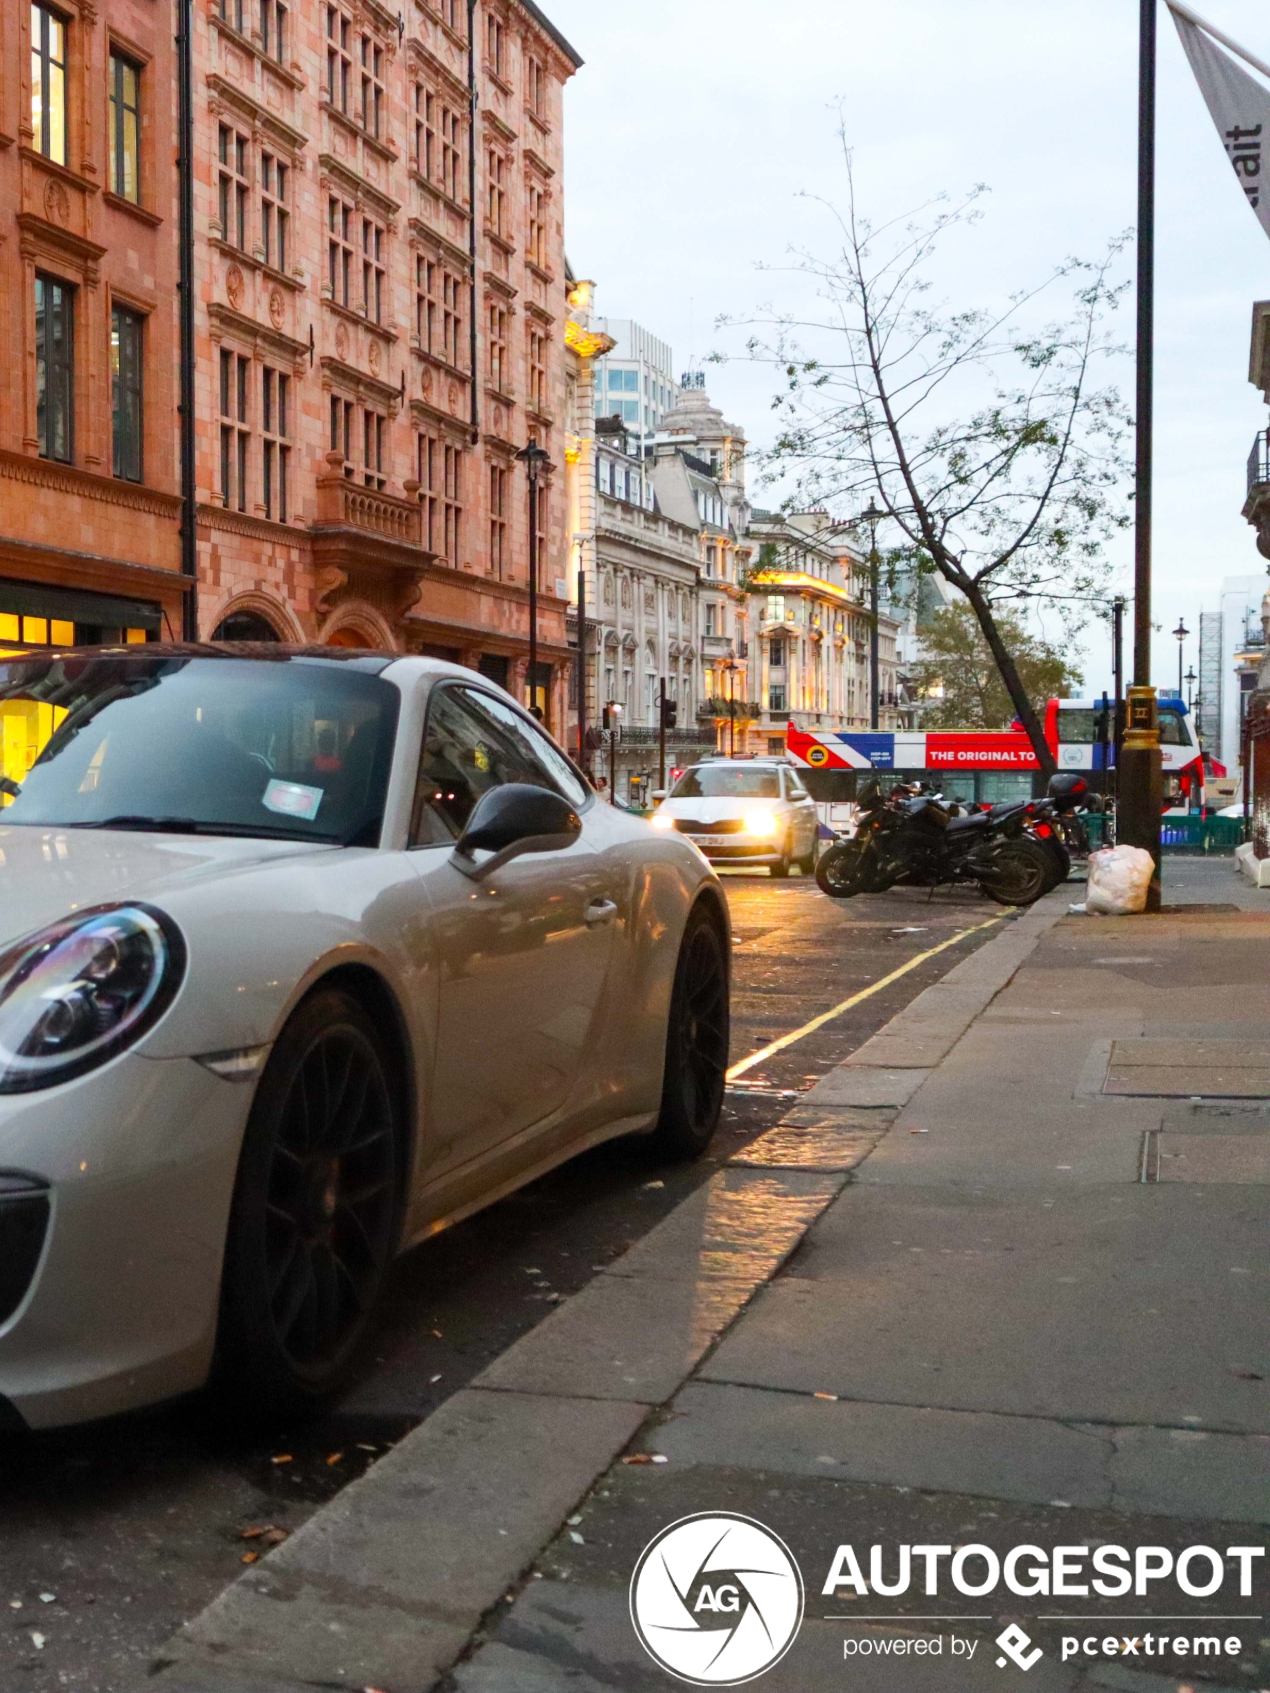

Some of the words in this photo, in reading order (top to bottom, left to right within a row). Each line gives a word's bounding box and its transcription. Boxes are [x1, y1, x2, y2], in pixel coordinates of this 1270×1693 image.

[930, 751, 955, 761] THE
[957, 751, 1017, 761] ORIGINAL
[1018, 751, 1036, 761] TO
